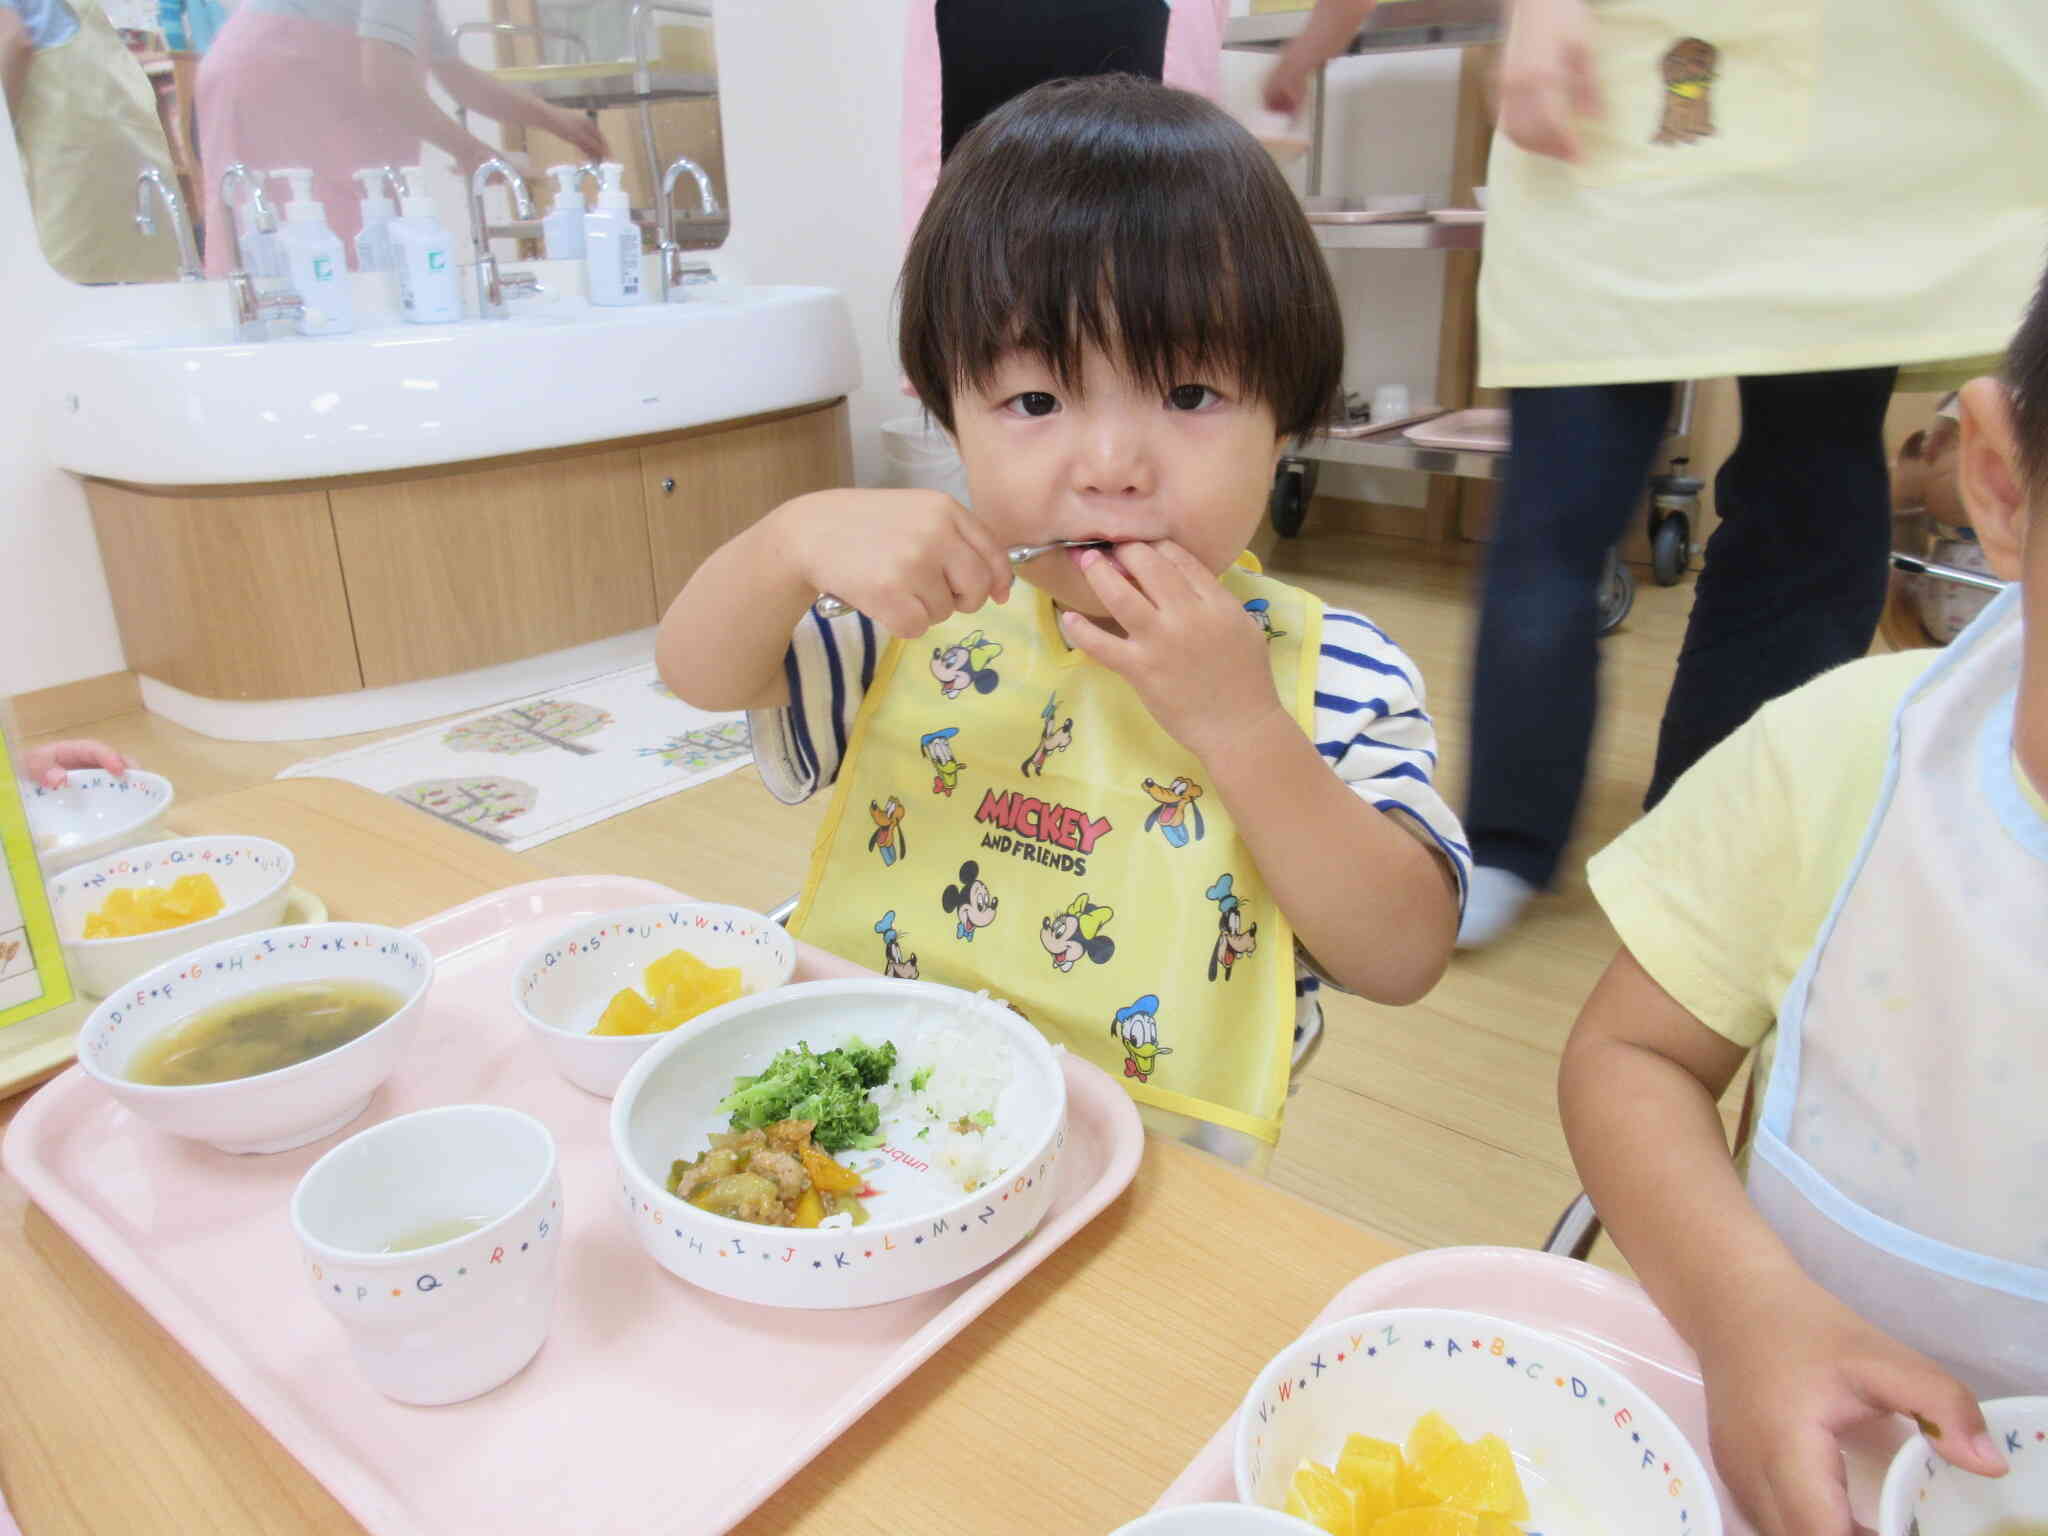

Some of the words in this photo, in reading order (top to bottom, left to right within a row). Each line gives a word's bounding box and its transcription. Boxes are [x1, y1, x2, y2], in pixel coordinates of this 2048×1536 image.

[974, 788, 1112, 855] MICKEY
[170, 850, 186, 863] Q
[981, 832, 1011, 853] AND
[1012, 841, 1087, 876] FRIENDS
[545, 953, 557, 966] Q
[568, 941, 577, 956] R
[590, 937, 600, 950] S
[640, 925, 650, 938] U
[669, 912, 678, 924] V
[696, 915, 709, 928] W
[724, 920, 734, 933] X
[136, 991, 145, 1005] E
[230, 956, 243, 970] H
[300, 936, 312, 948] J
[335, 937, 345, 950] K
[731, 1239, 745, 1254] I
[782, 1248, 796, 1262] J
[834, 1252, 850, 1268] K
[885, 1235, 896, 1250] L
[933, 1218, 949, 1237] M
[978, 1205, 995, 1224] N
[417, 1274, 442, 1291] Q
[490, 1247, 504, 1263] R
[1278, 1378, 1292, 1402] W
[1310, 1354, 1327, 1378] X
[1350, 1334, 1363, 1350] Y
[1382, 1325, 1400, 1346] Z
[1447, 1338, 1462, 1357] A
[1490, 1336, 1504, 1356] B
[1526, 1363, 1543, 1379] C
[1571, 1376, 1587, 1398] D
[1614, 1408, 1632, 1428] E
[1641, 1449, 1655, 1469] F
[2005, 1429, 2022, 1453] K
